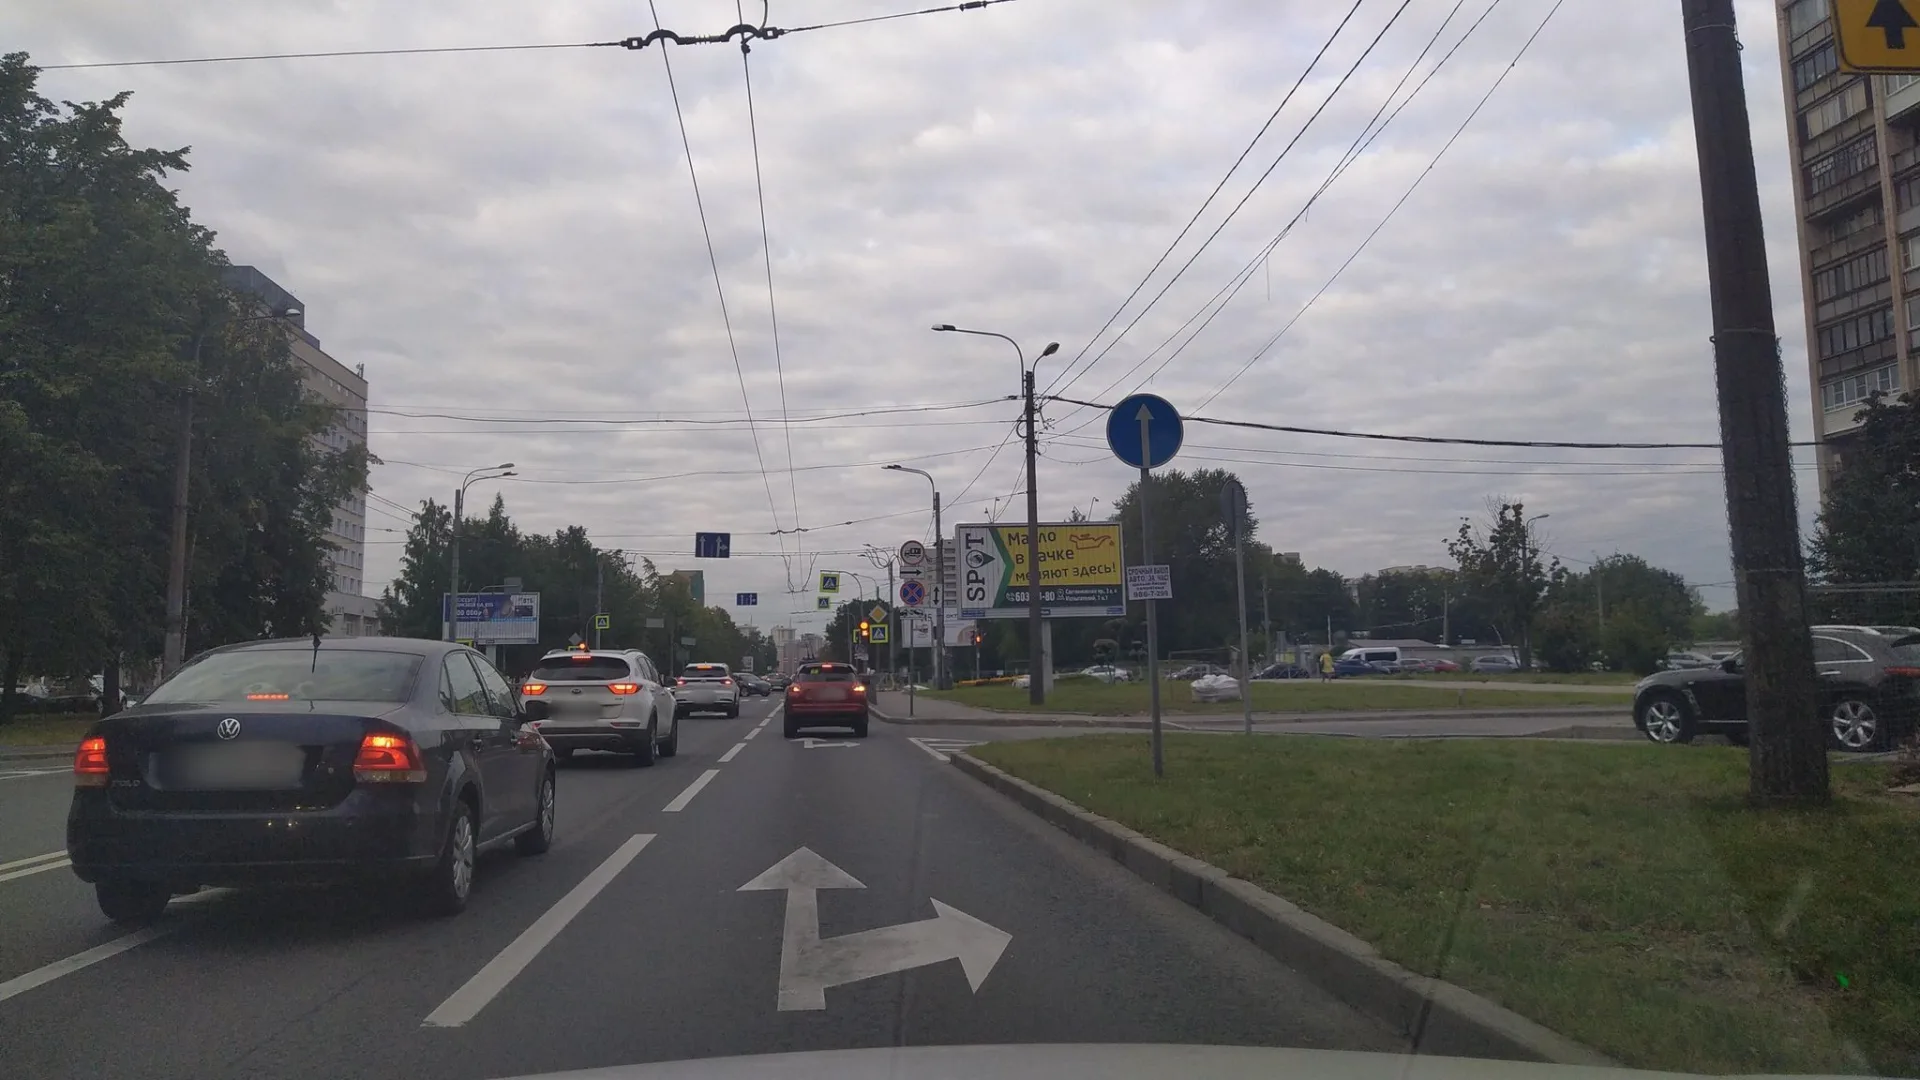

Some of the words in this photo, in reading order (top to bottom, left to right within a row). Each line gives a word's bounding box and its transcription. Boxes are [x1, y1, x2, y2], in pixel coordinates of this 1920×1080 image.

[1007, 531, 1056, 546] Мало
[1015, 553, 1025, 565] в
[1036, 549, 1075, 563] ачке
[1072, 562, 1116, 578] здесь!
